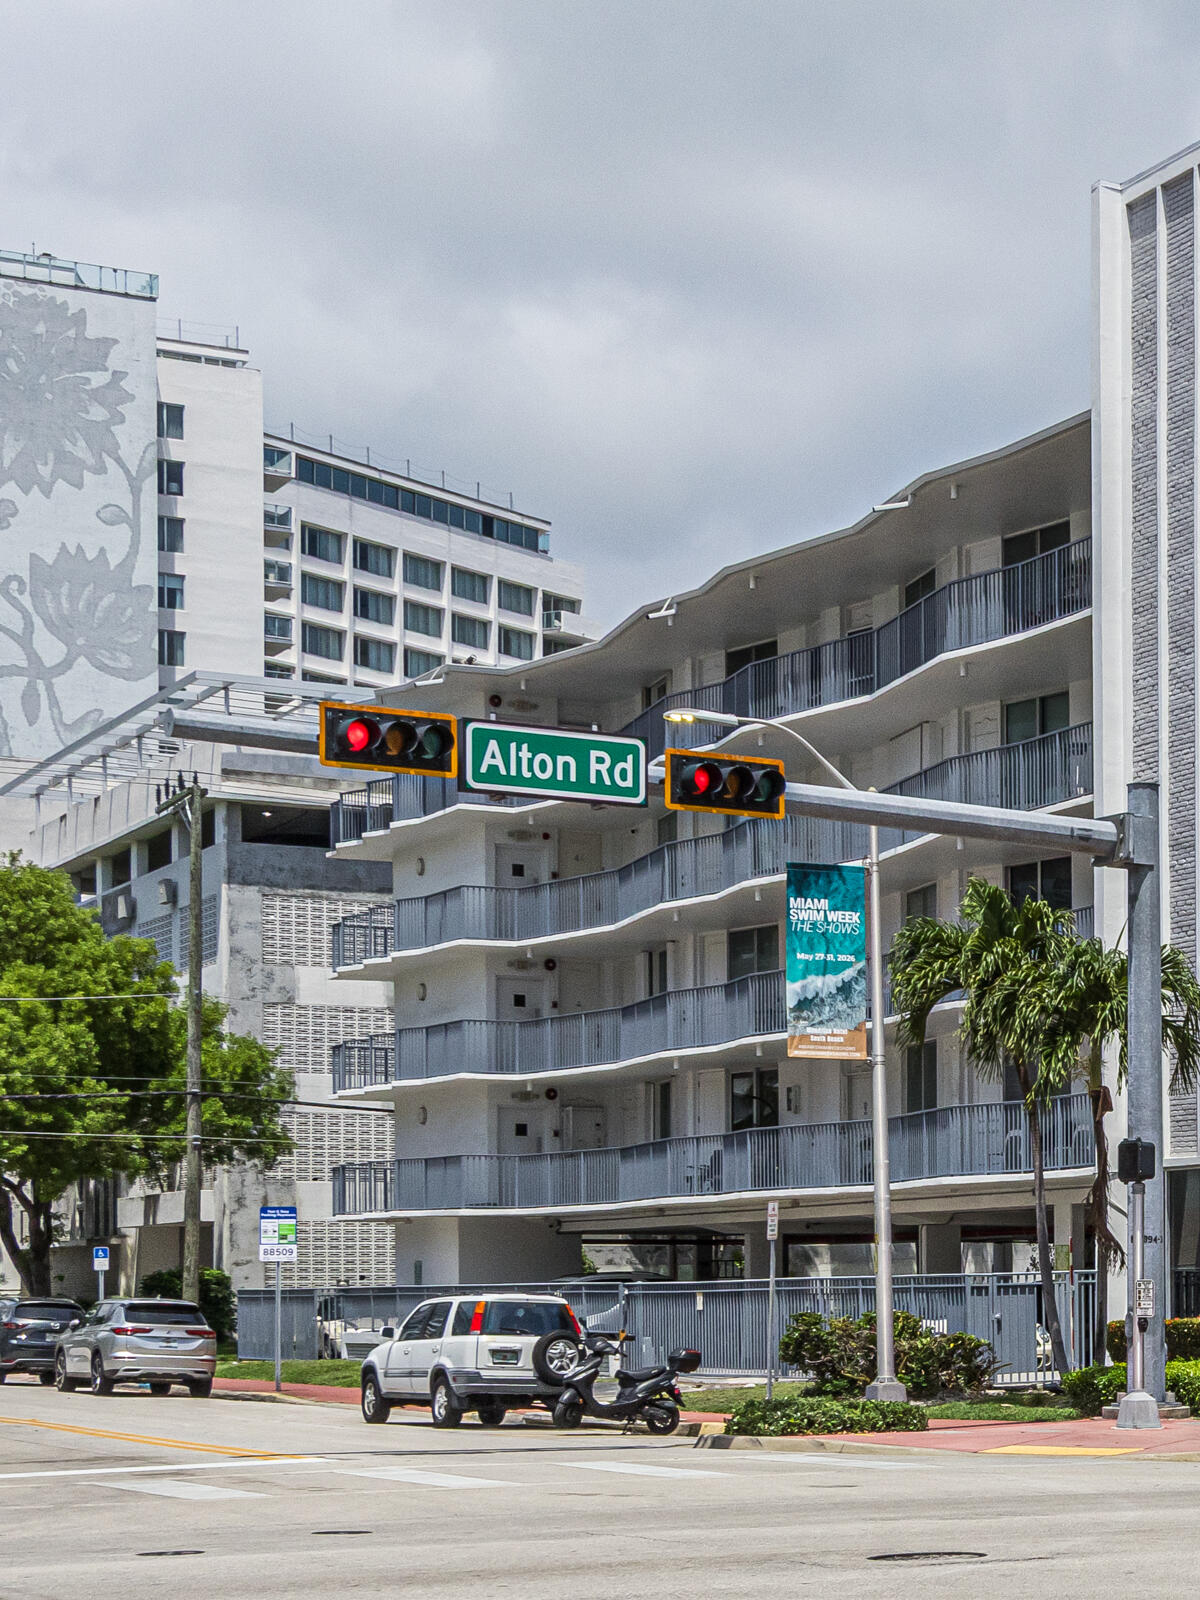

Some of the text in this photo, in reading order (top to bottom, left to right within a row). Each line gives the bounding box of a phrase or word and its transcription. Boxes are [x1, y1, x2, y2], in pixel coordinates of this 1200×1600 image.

[480, 739, 633, 788] Alton Rd
[789, 897, 828, 910] MIAMI
[789, 909, 861, 924] SWIM WEEK
[791, 920, 860, 935] THE SHOWS
[796, 952, 813, 961] May
[837, 954, 856, 962] 2026
